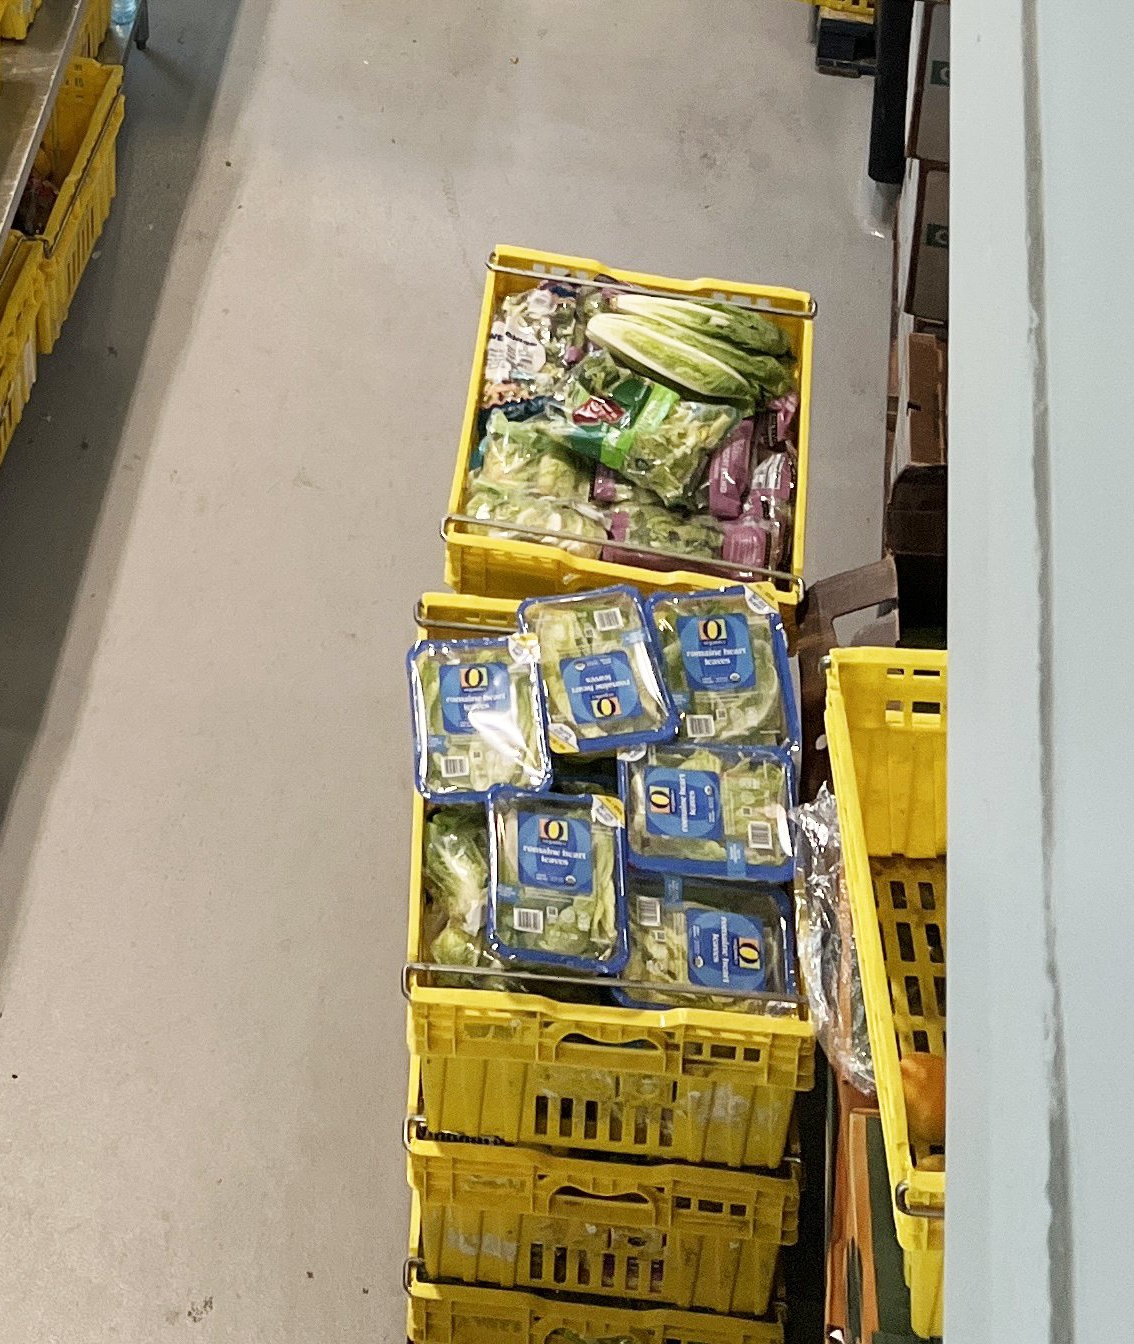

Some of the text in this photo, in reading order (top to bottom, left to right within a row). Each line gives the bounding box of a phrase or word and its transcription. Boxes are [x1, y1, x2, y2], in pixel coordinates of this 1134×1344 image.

[686, 646, 747, 658] romaine heart
[571, 679, 631, 694] romaine heart
[678, 773, 689, 833] romaine heart
[522, 844, 587, 861] romaine heart
[720, 916, 730, 984] romaine heart
